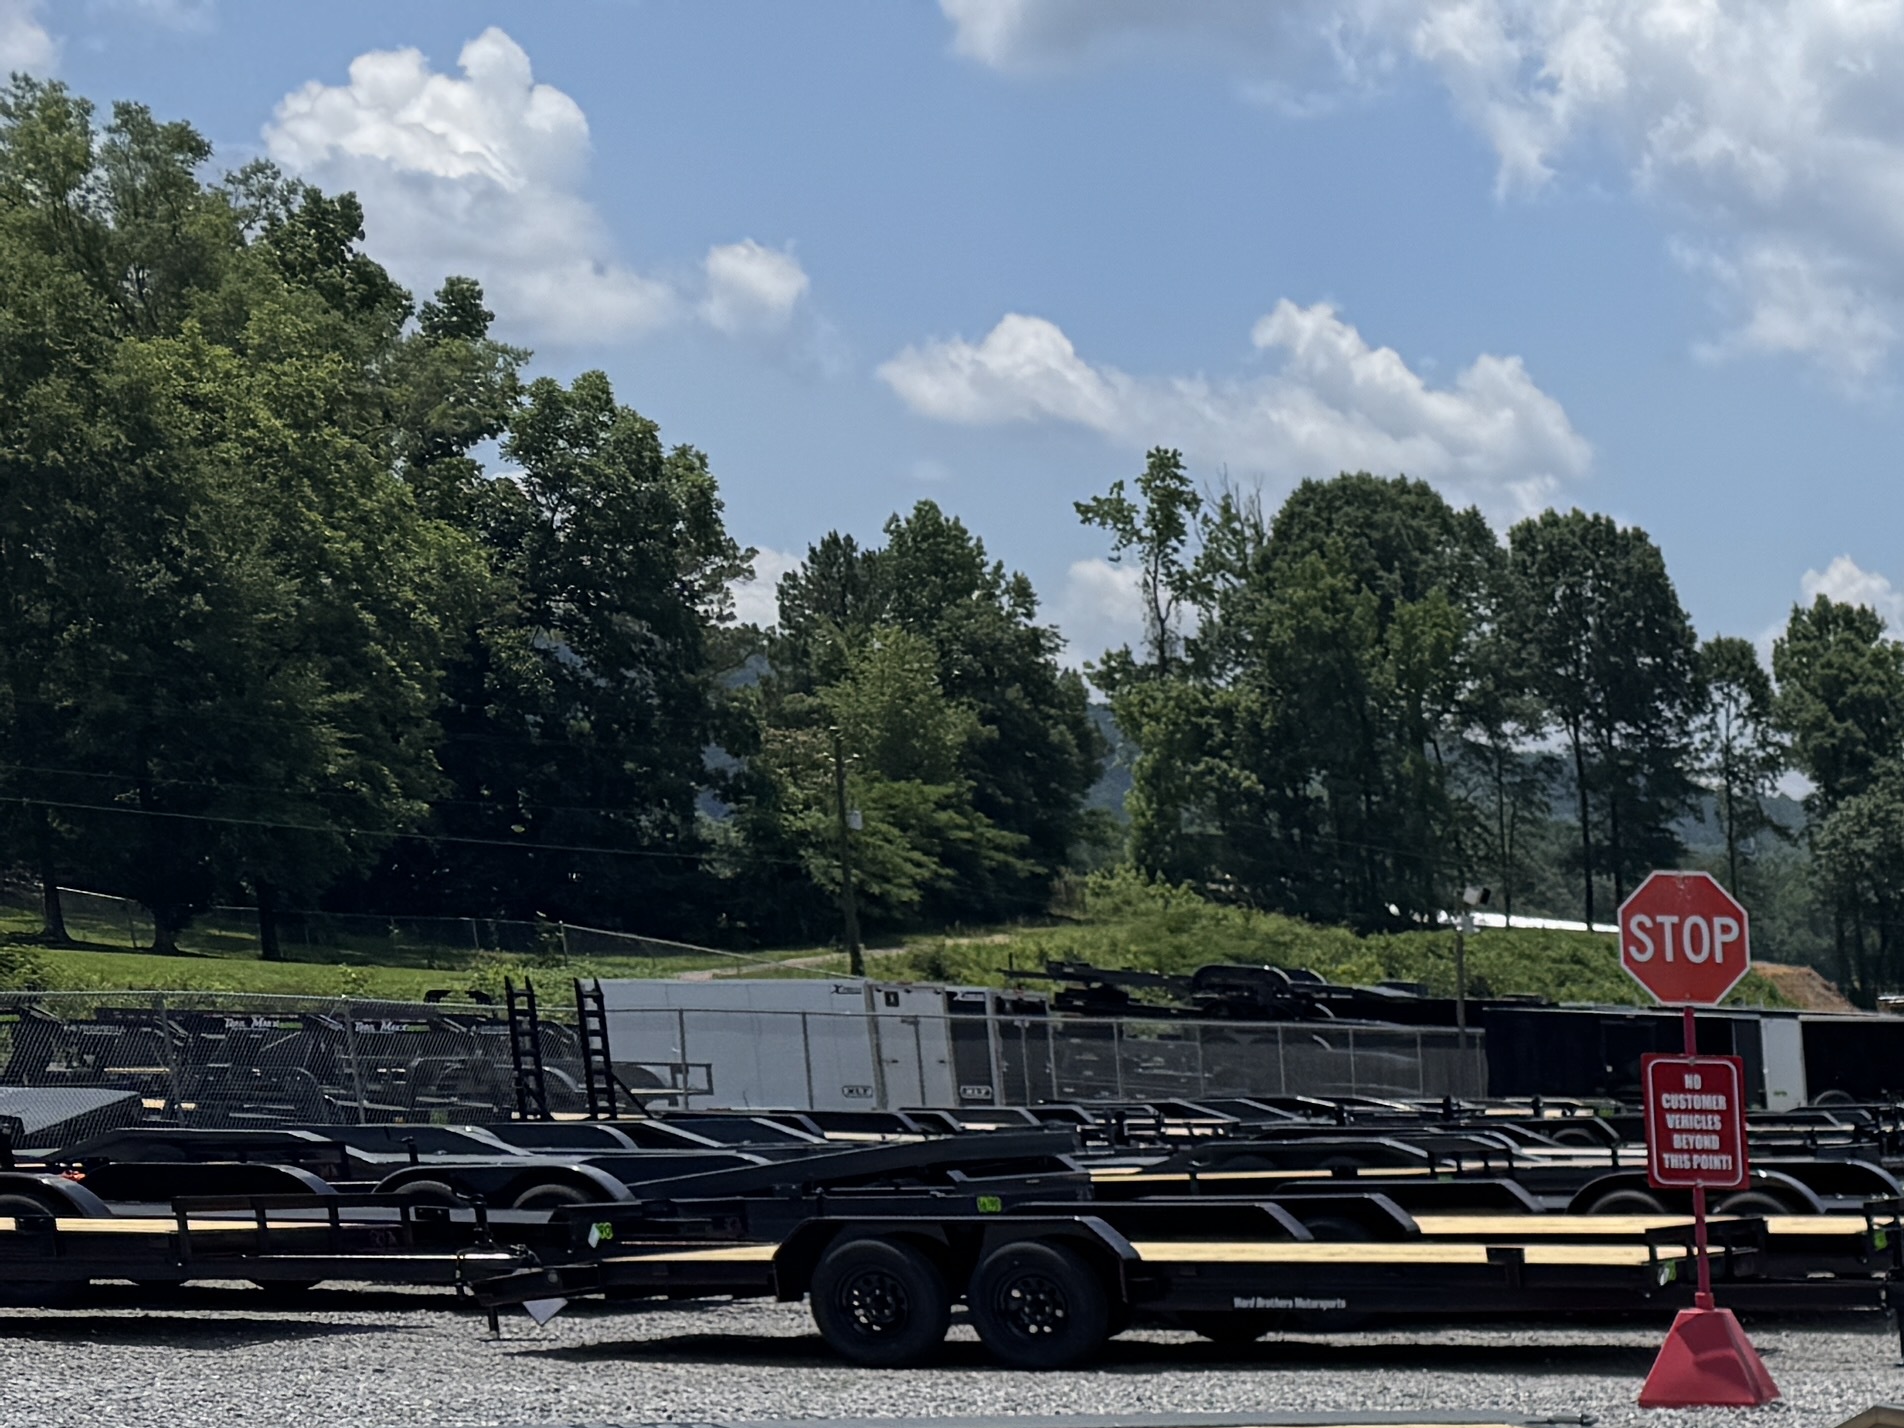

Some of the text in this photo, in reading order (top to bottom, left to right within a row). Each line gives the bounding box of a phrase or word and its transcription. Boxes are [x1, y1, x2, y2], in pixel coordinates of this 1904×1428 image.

[1628, 914, 1740, 964] STOP
[1684, 1073, 1702, 1090] NO
[1661, 1093, 1727, 1111] CUSTOMER
[1665, 1113, 1722, 1131] VEHICLES
[1672, 1134, 1720, 1151] BEYOND
[1662, 1152, 1733, 1171] THIS POINT!
